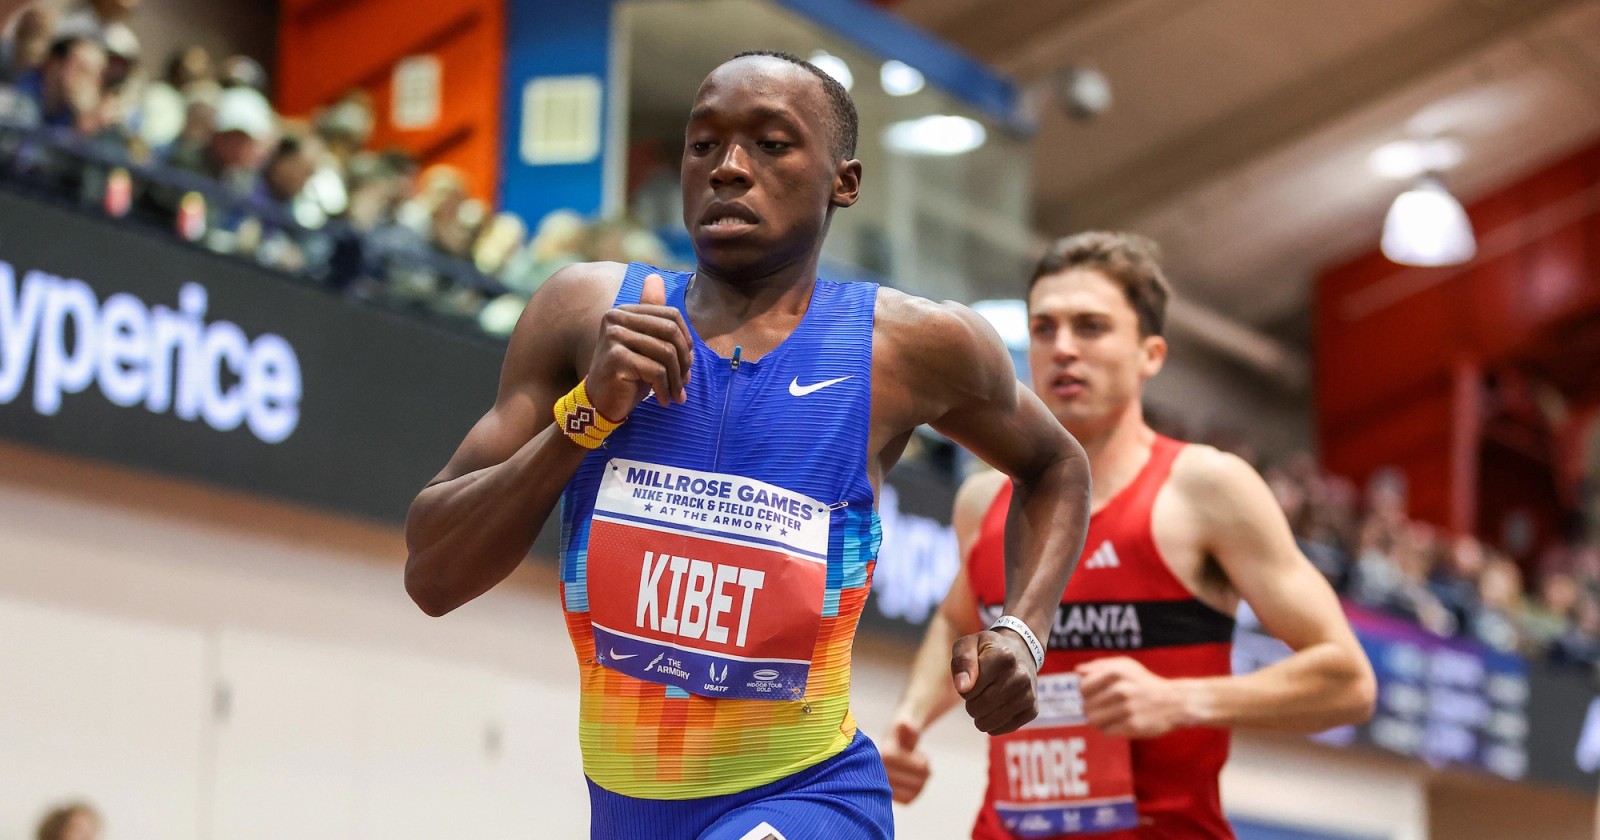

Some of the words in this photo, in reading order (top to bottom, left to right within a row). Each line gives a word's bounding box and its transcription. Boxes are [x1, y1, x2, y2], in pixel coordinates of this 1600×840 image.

[626, 467, 733, 499] MILLROSE
[737, 485, 813, 521] GAMES
[632, 488, 663, 502] NIKE
[666, 492, 706, 510] TRACK
[707, 499, 716, 511] &
[718, 502, 755, 517] FIELD
[757, 508, 802, 532] CENTER
[660, 506, 677, 516] AT
[683, 510, 708, 522] THE
[713, 515, 773, 533] ARMORY
[635, 550, 766, 648] KIBET
[657, 665, 691, 680] ARMORY
[667, 657, 682, 669] THE
[704, 683, 729, 693] USATF
[1004, 736, 1091, 800] FIORE
